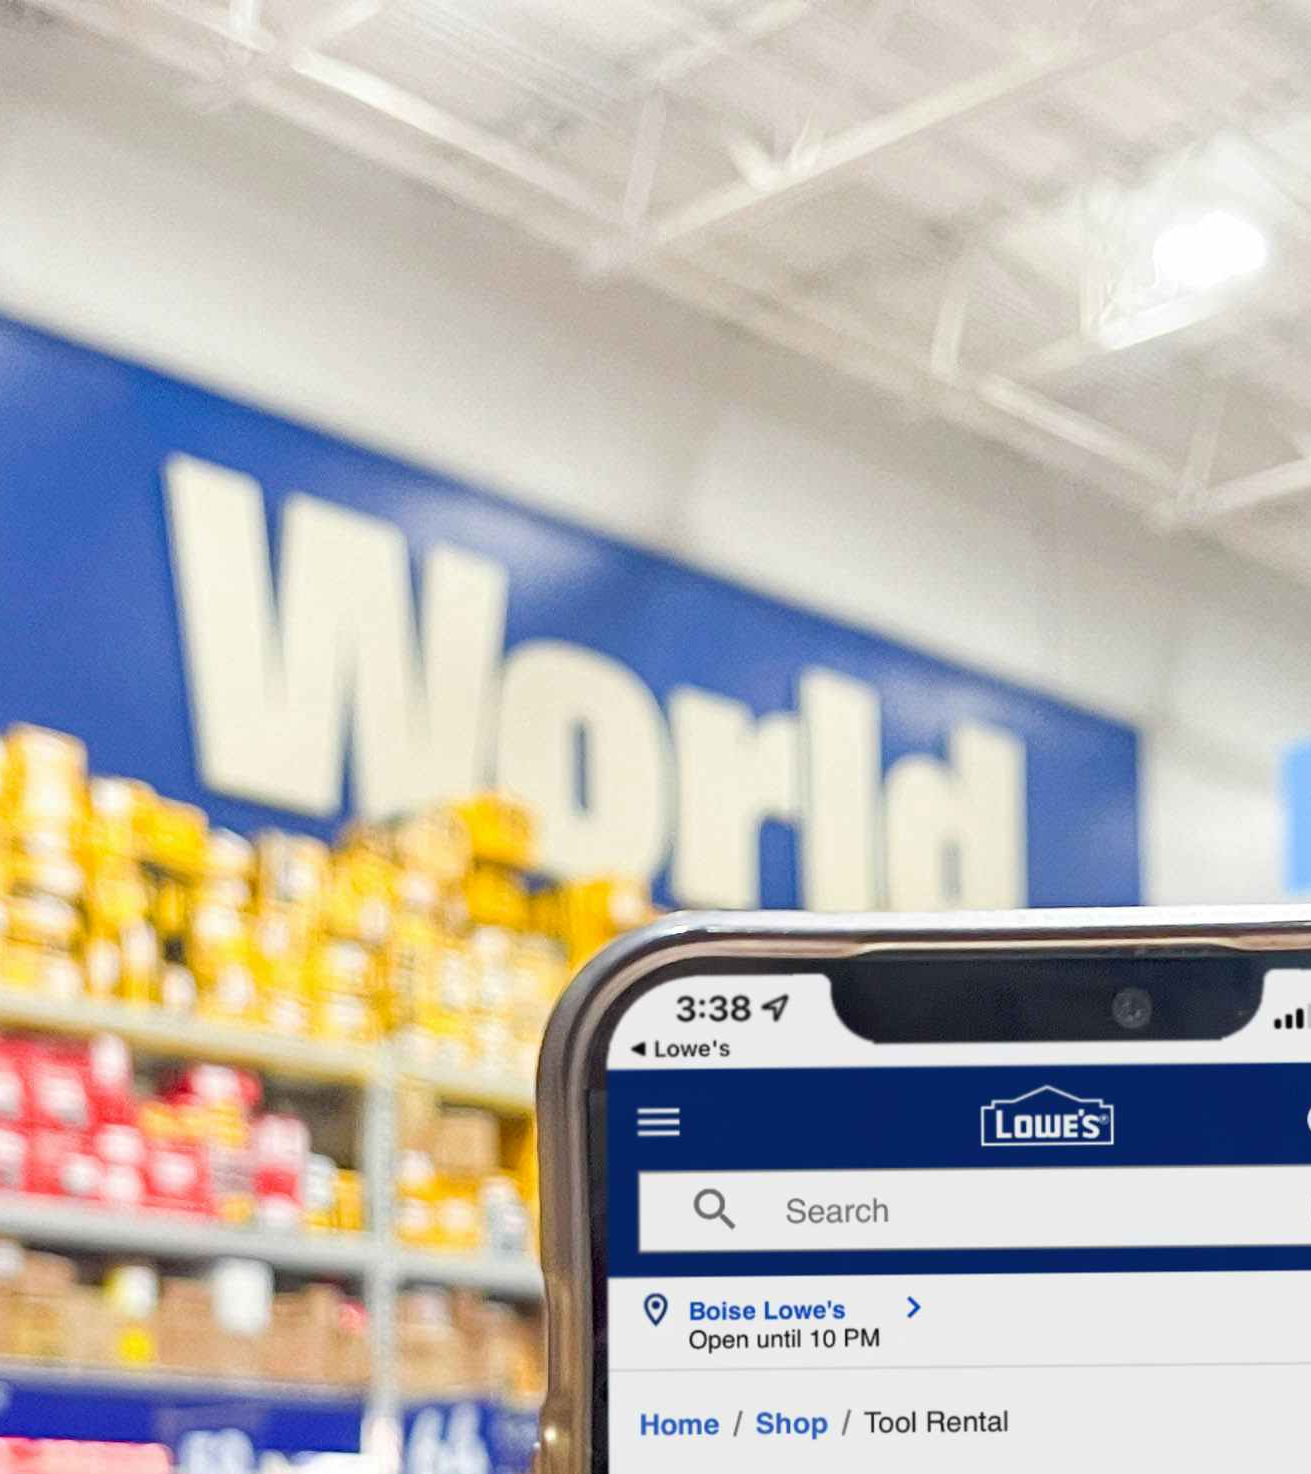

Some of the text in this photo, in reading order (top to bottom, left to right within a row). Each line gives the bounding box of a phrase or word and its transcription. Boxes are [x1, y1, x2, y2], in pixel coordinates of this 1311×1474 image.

[164, 450, 1028, 910] World
[677, 995, 751, 1022] 3:38
[655, 1040, 730, 1057] Lowe's
[995, 1108, 1101, 1139] LOWE'S
[786, 1198, 888, 1224] Search
[690, 1301, 845, 1320] Boise Lowe's
[689, 1328, 879, 1353] Open until 10 PM
[641, 1414, 719, 1435] Home
[757, 1412, 828, 1439] Shop
[864, 1411, 916, 1433] Tool
[928, 1411, 1007, 1432] Rental
